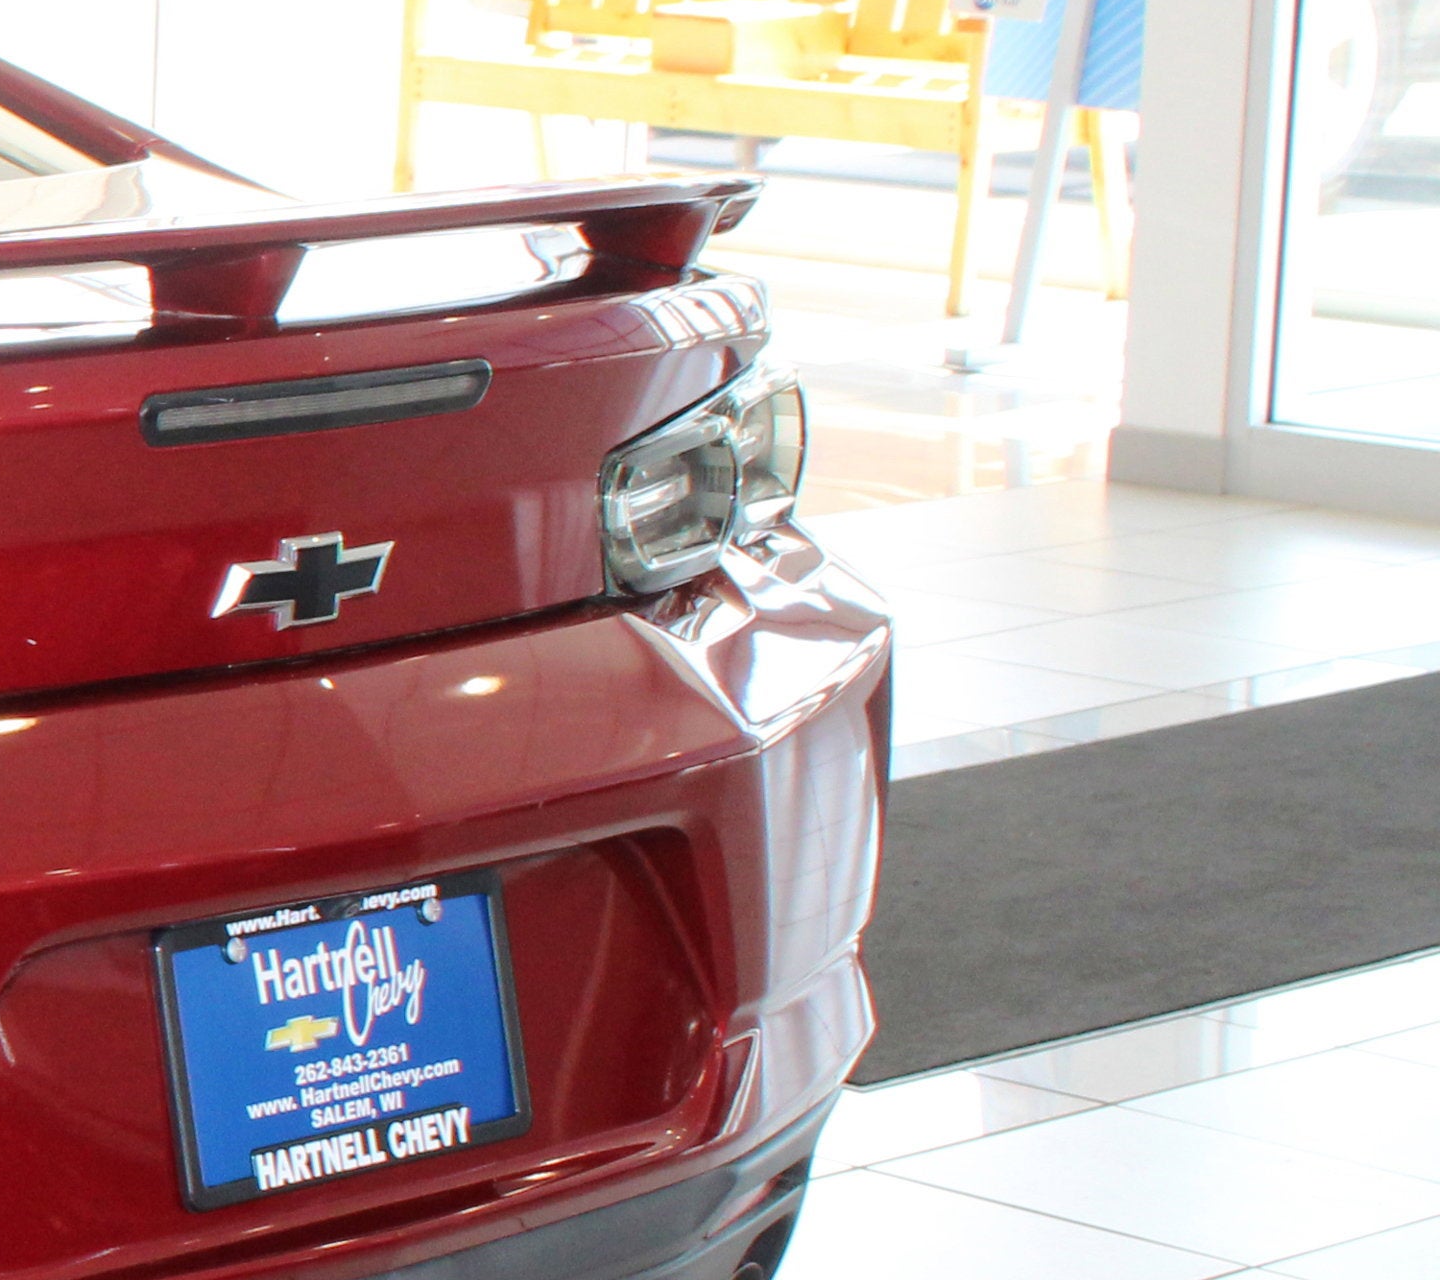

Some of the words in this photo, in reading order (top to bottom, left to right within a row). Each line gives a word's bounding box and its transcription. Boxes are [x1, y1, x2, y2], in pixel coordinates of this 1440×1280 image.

[252, 926, 398, 1005] Hartnell
[343, 920, 426, 1047] Chevy
[246, 1096, 298, 1119] www.
[300, 1058, 461, 1108] HartnellChevy.com
[293, 1043, 409, 1086] 262-843-2361
[310, 1097, 377, 1129] SALEM,
[380, 1090, 404, 1112] WI
[254, 1128, 389, 1191] HARTNELL
[387, 1106, 470, 1159] CHEVY
